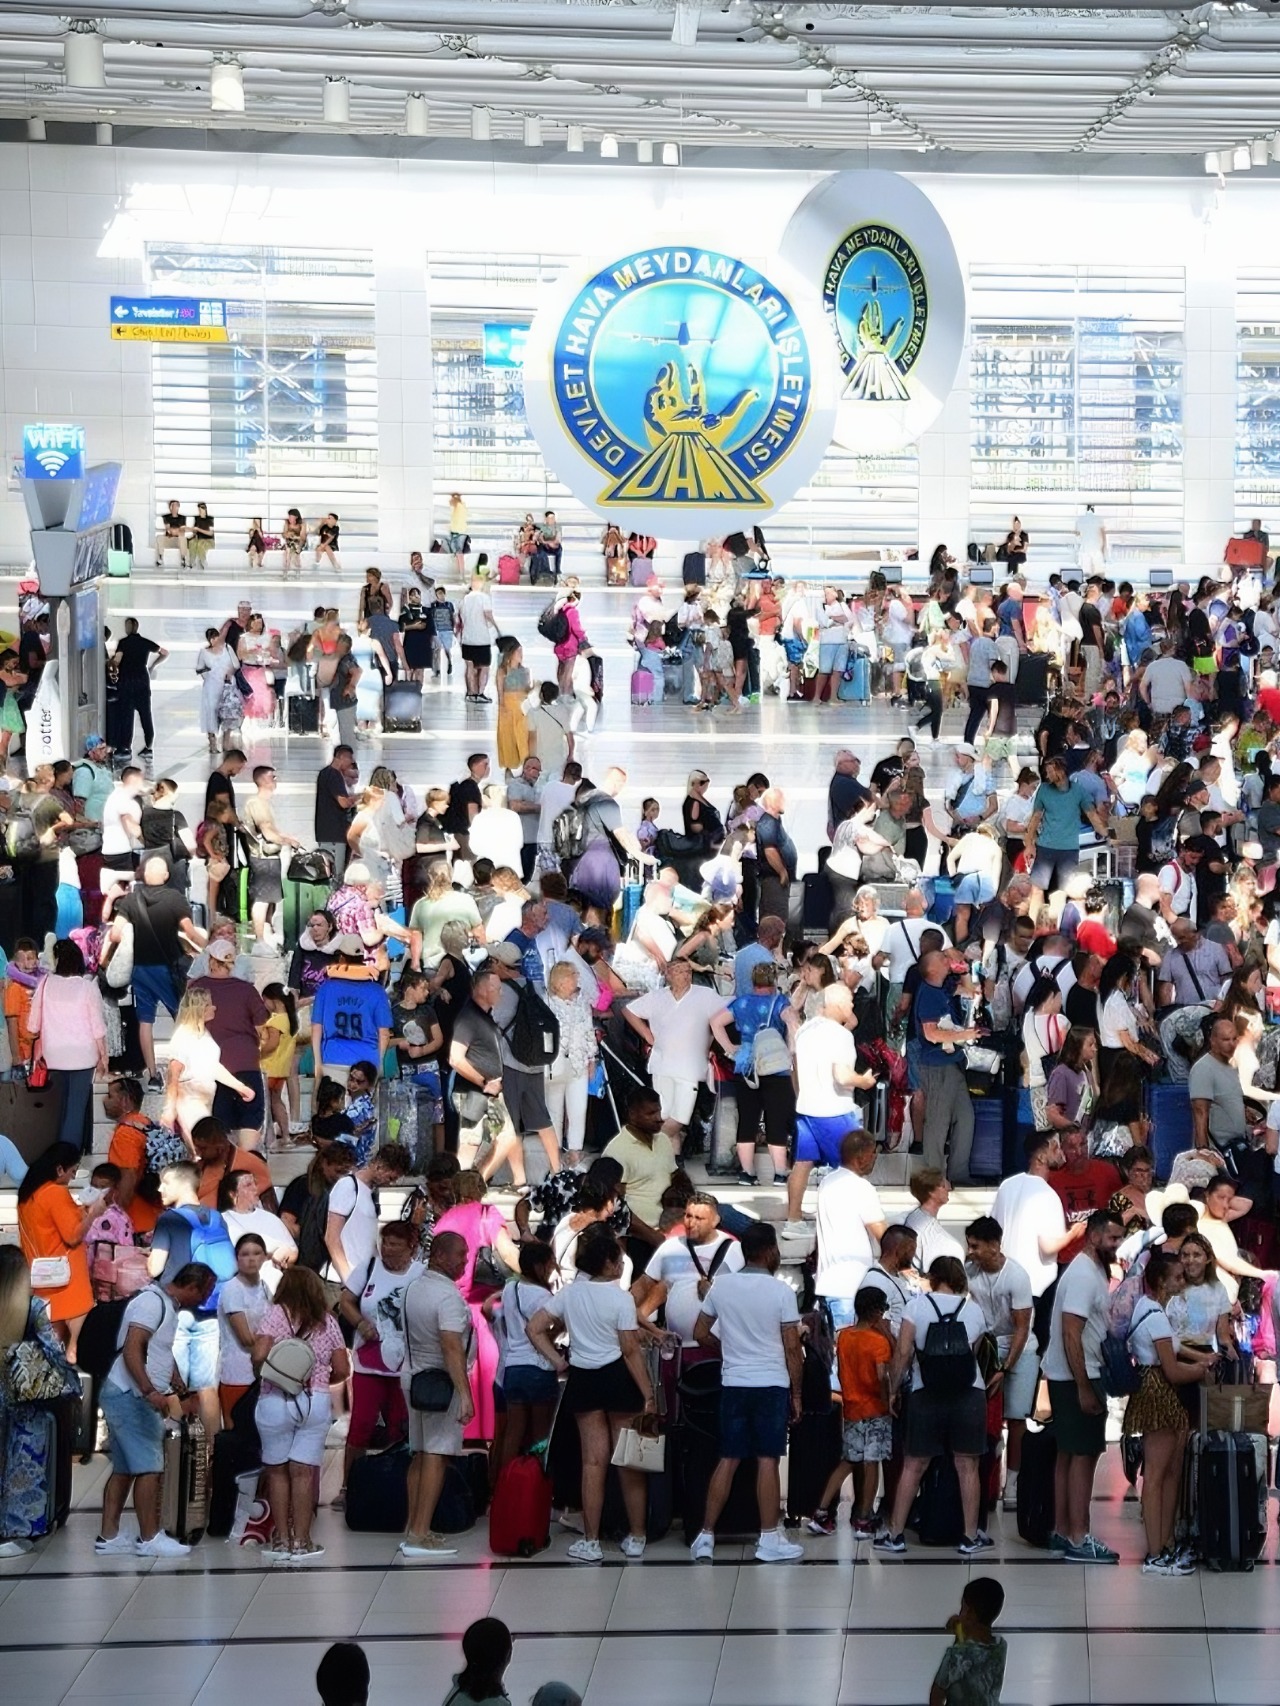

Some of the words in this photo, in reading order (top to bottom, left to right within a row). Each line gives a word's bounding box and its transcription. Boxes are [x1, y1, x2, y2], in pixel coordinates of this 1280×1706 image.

[565, 286, 617, 356] HAVA
[612, 251, 788, 325] MEYDANLARI
[563, 364, 627, 467] DEVLET
